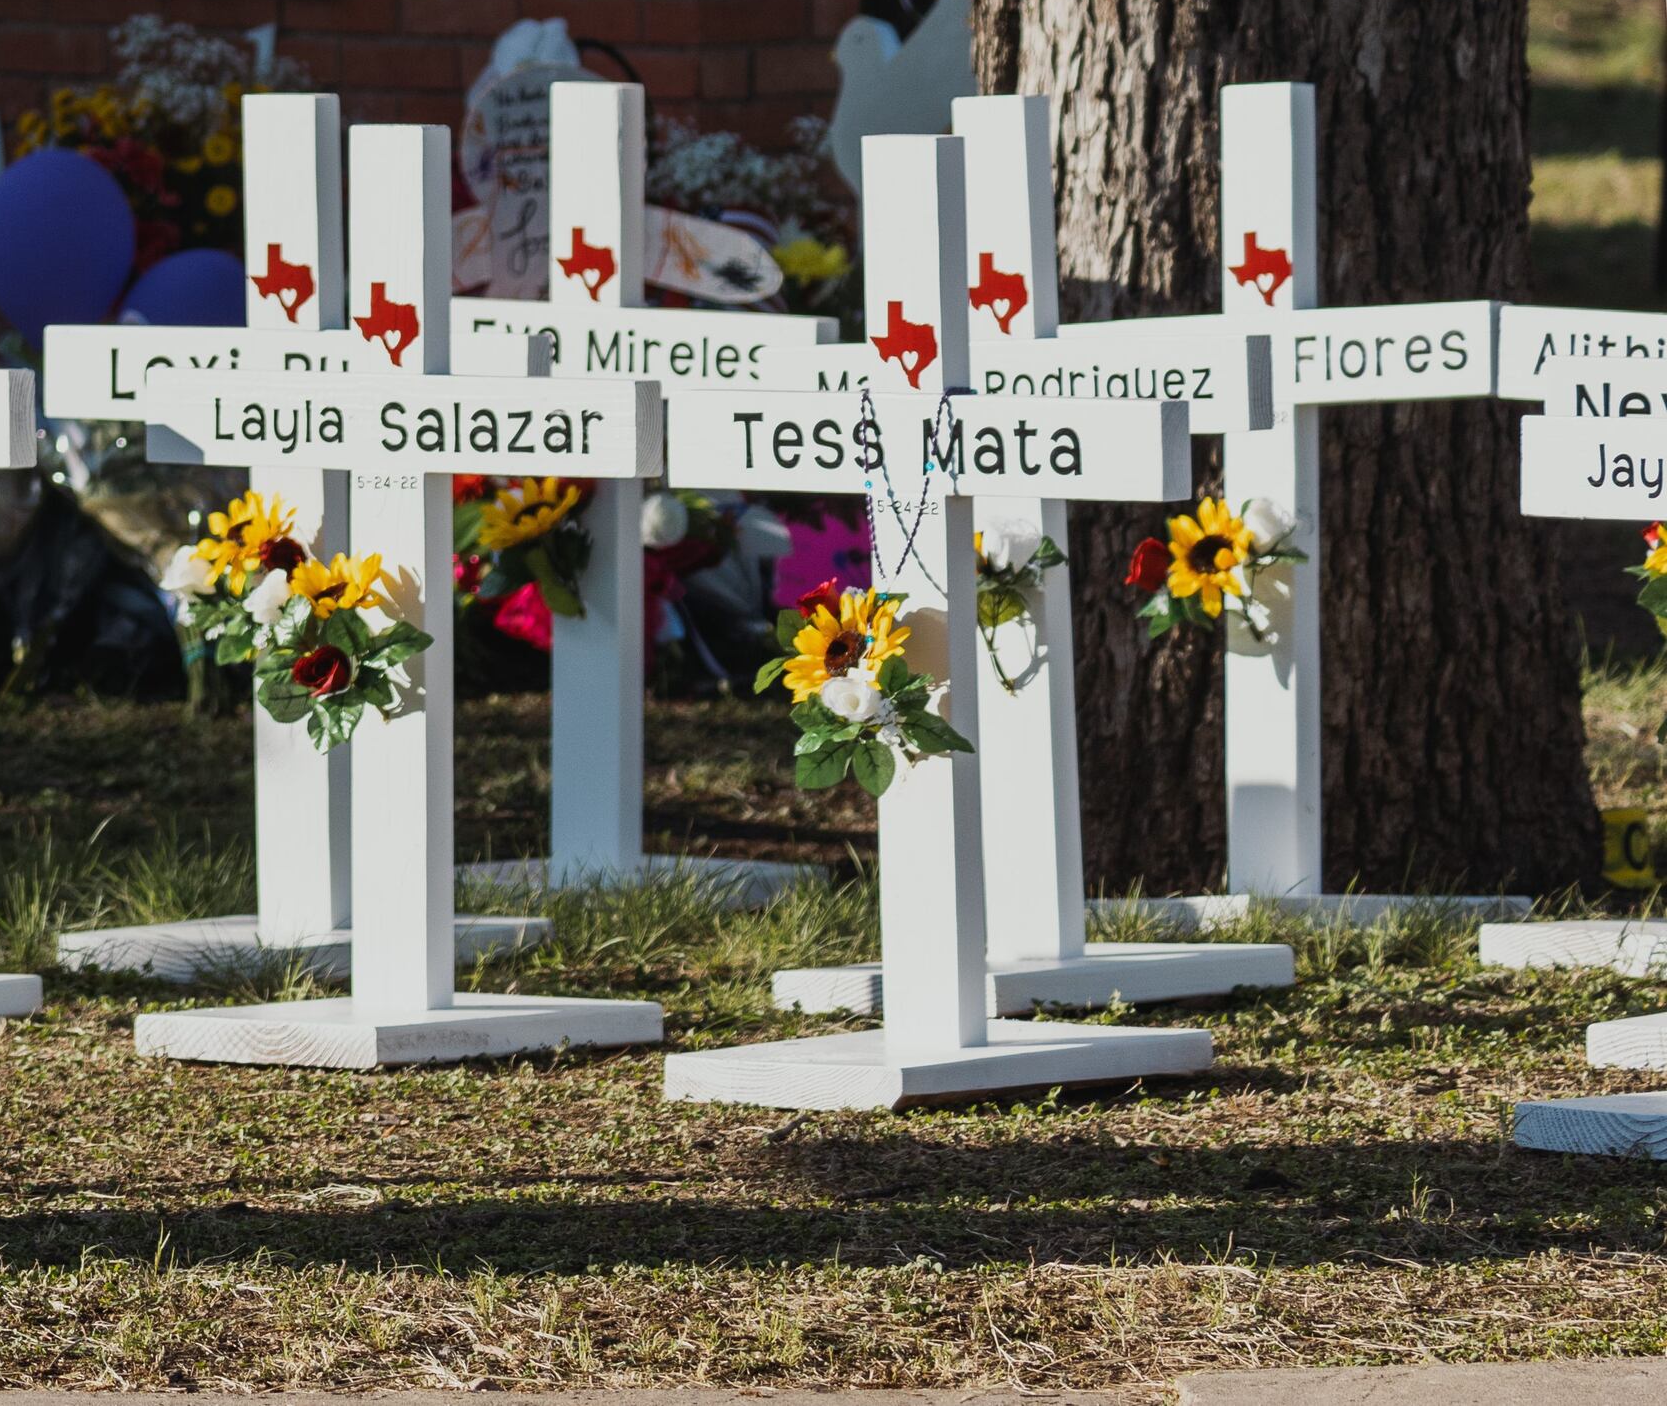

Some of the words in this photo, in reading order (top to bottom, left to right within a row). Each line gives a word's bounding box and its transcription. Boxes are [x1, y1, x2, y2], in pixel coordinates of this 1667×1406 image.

[1293, 328, 1469, 384] Flores
[214, 396, 345, 455] Layla
[380, 400, 605, 455] Salazar
[732, 411, 885, 470] Tess
[923, 415, 1083, 476] Mata
[356, 475, 419, 491] 5-24-22
